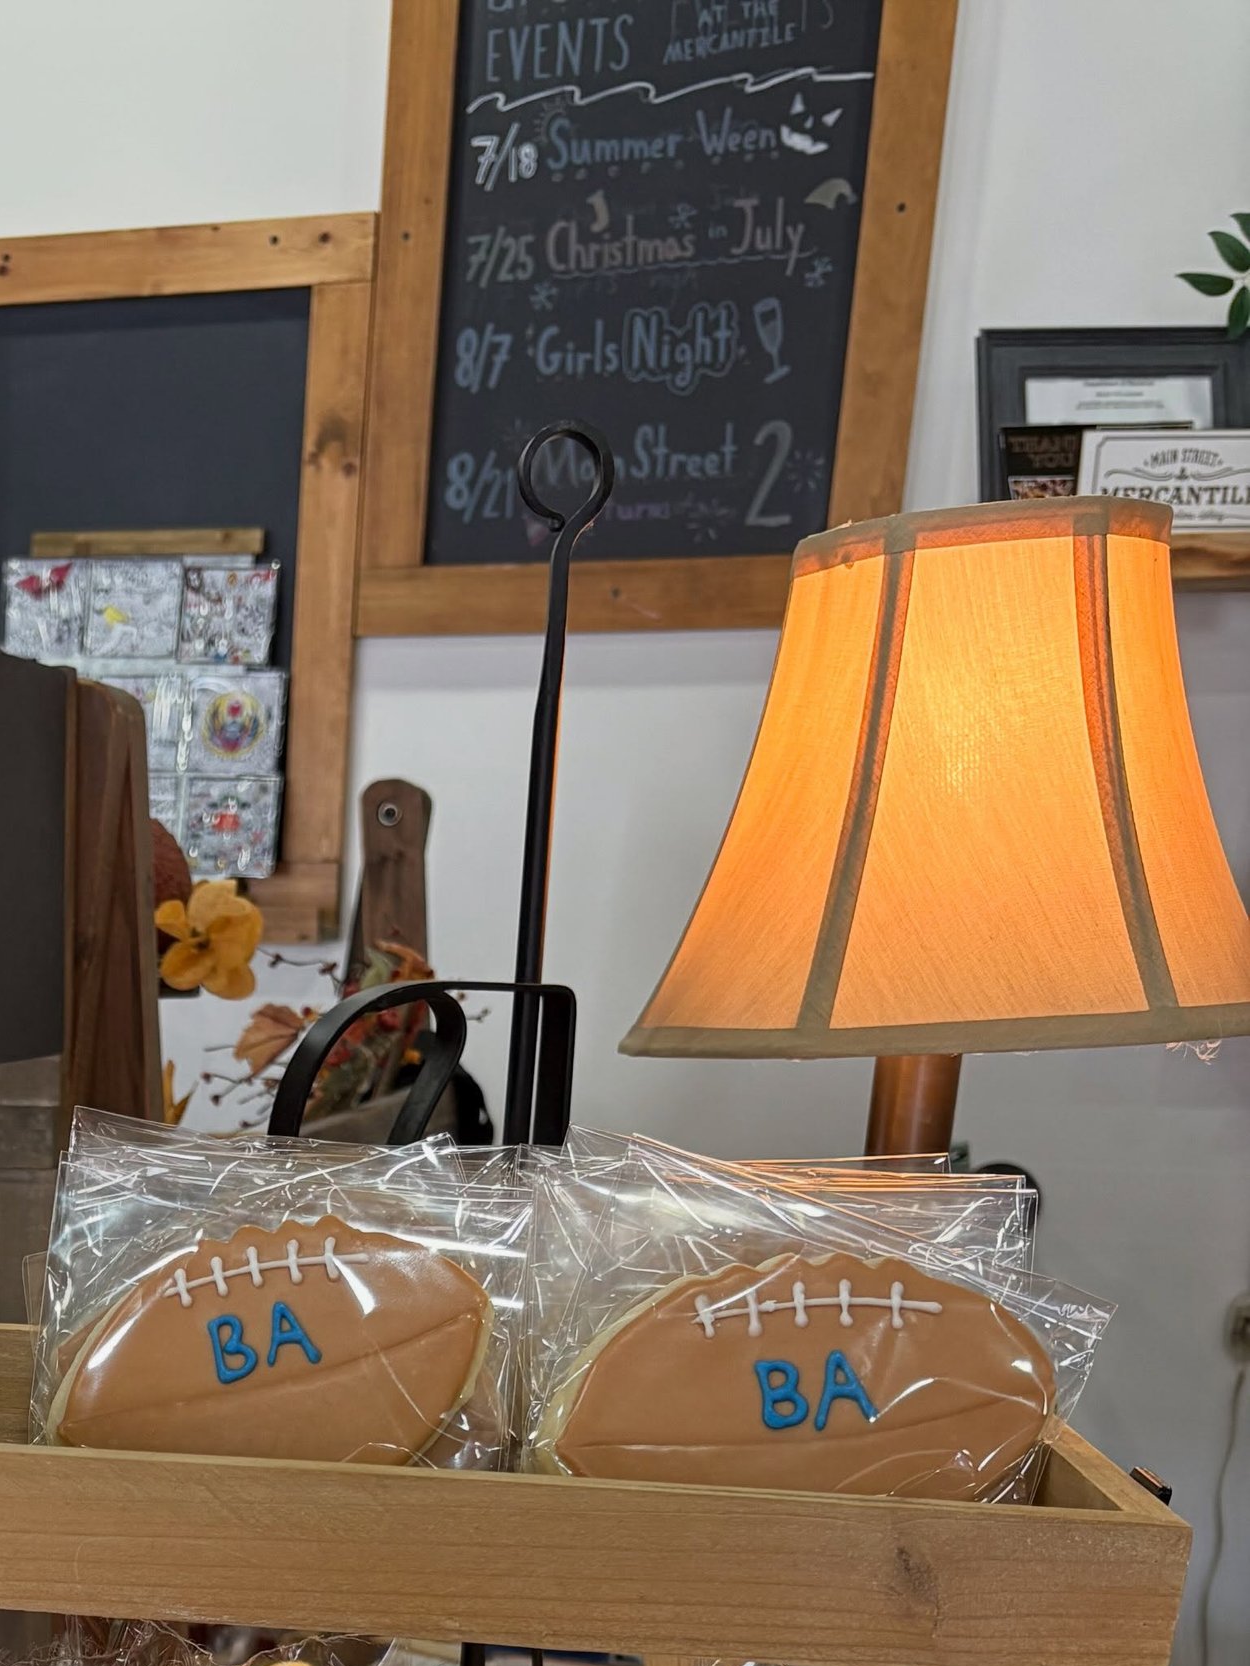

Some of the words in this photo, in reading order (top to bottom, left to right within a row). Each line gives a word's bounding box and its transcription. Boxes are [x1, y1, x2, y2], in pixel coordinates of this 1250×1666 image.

[486, 15, 635, 82] EVENTS
[663, 23, 795, 65] MERCANTILE
[470, 123, 538, 190] 7/18
[549, 120, 684, 171] Summer
[697, 107, 777, 155] Ween
[466, 227, 535, 287] 7/25
[547, 215, 696, 271] Christmas
[708, 221, 727, 238] in
[731, 198, 805, 276] July
[455, 323, 512, 393] 8/7
[534, 319, 620, 375] Girls
[630, 307, 734, 382] Night
[547, 439, 625, 488] Man
[632, 422, 737, 479] Street
[745, 420, 793, 527] 2
[1101, 486, 1250, 506] MERCANTIL
[1150, 450, 1178, 467] MAIN
[1180, 448, 1219, 466] STREET
[206, 1300, 323, 1384] BA
[754, 1350, 878, 1432] BA
